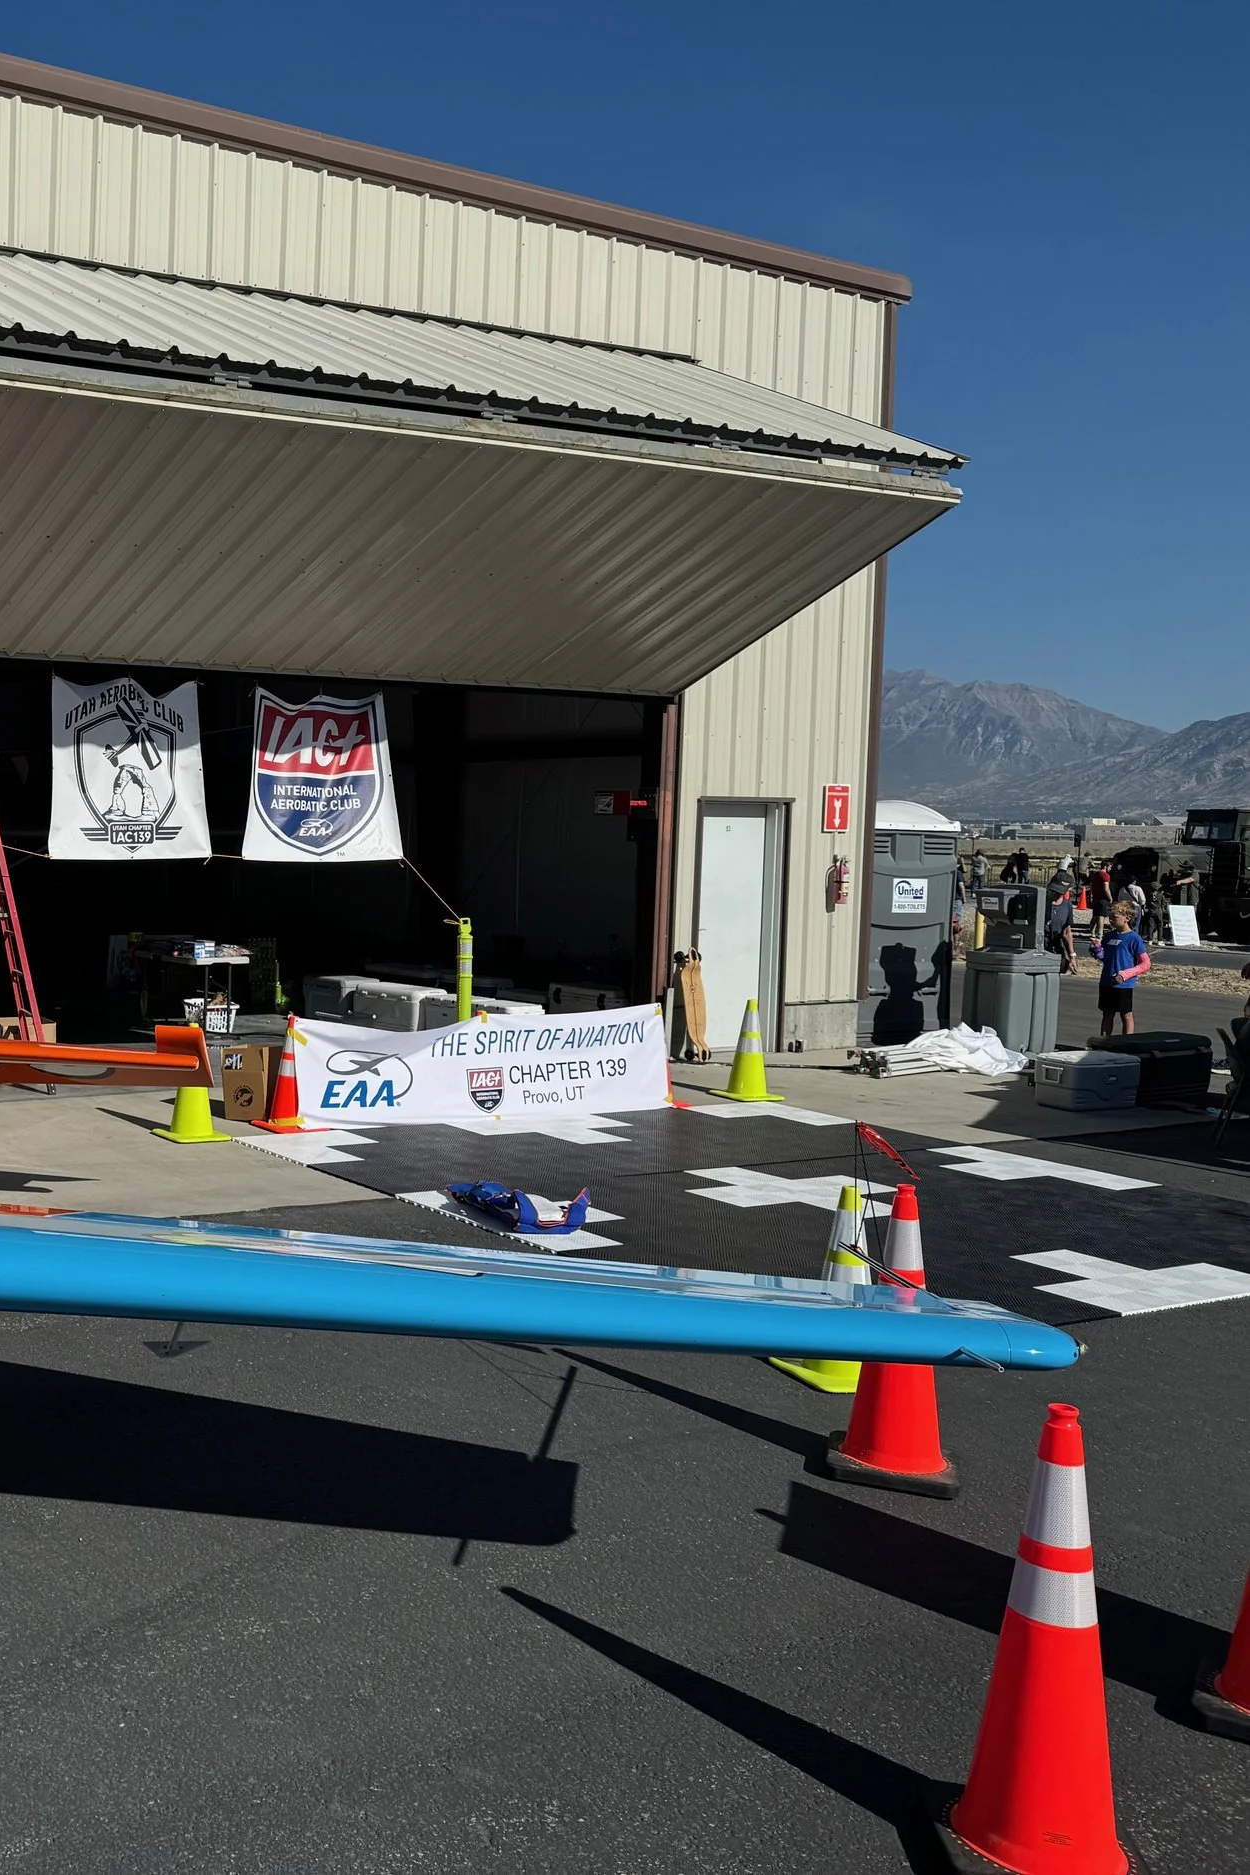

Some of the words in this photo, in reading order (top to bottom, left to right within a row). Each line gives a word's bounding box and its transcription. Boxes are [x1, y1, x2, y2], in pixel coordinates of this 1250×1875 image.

[65, 697, 97, 730] UTAH
[154, 700, 184, 733] CLUB
[264, 716, 339, 767] IAC
[273, 784, 357, 798] INTERNATIONAL
[270, 799, 328, 812] AEROBATIC
[330, 799, 361, 810] CLUB
[112, 831, 152, 843] IAC139
[299, 827, 326, 837] EAA
[897, 885, 924, 896] United
[431, 1032, 469, 1057] THE
[474, 1029, 535, 1055] SPIRIT
[536, 1028, 563, 1051] OF
[562, 1021, 645, 1050] AVIATION
[471, 1071, 496, 1088] IAC
[509, 1060, 592, 1085] CHAPTER
[596, 1058, 627, 1078] 139
[320, 1080, 395, 1108] EAA
[523, 1089, 562, 1104] Provo,
[565, 1086, 585, 1101] UT
